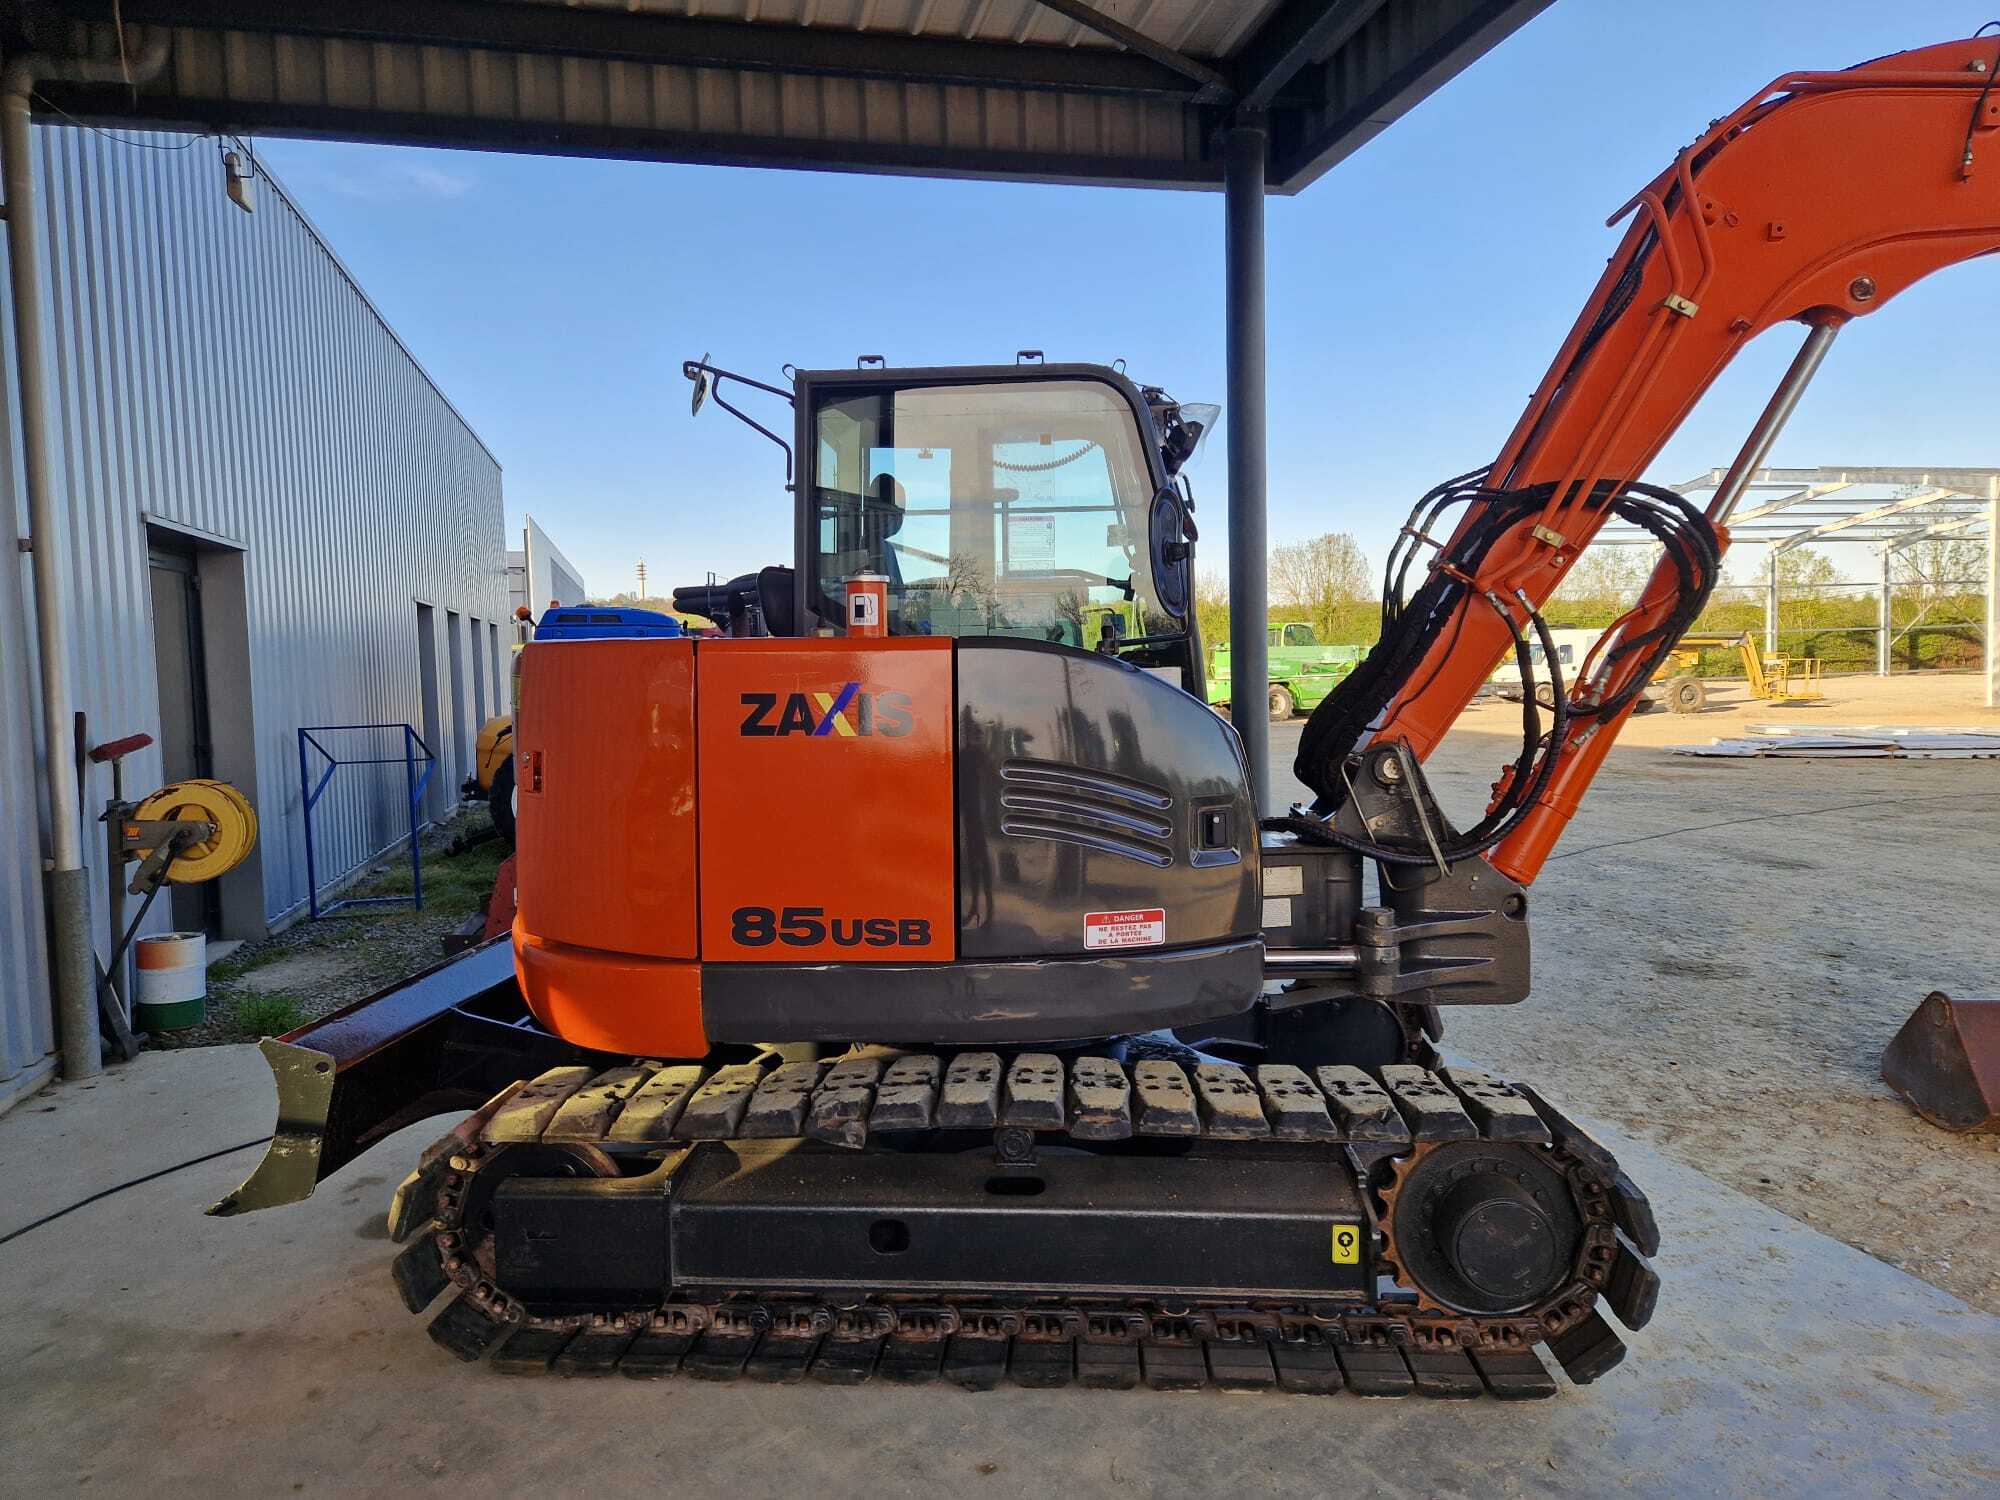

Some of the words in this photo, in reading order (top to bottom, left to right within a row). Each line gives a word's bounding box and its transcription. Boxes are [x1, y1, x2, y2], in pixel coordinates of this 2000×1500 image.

[740, 681, 913, 737] ZAXIS
[1114, 914, 1144, 922] DANGER
[1121, 935, 1152, 943] MACHINE
